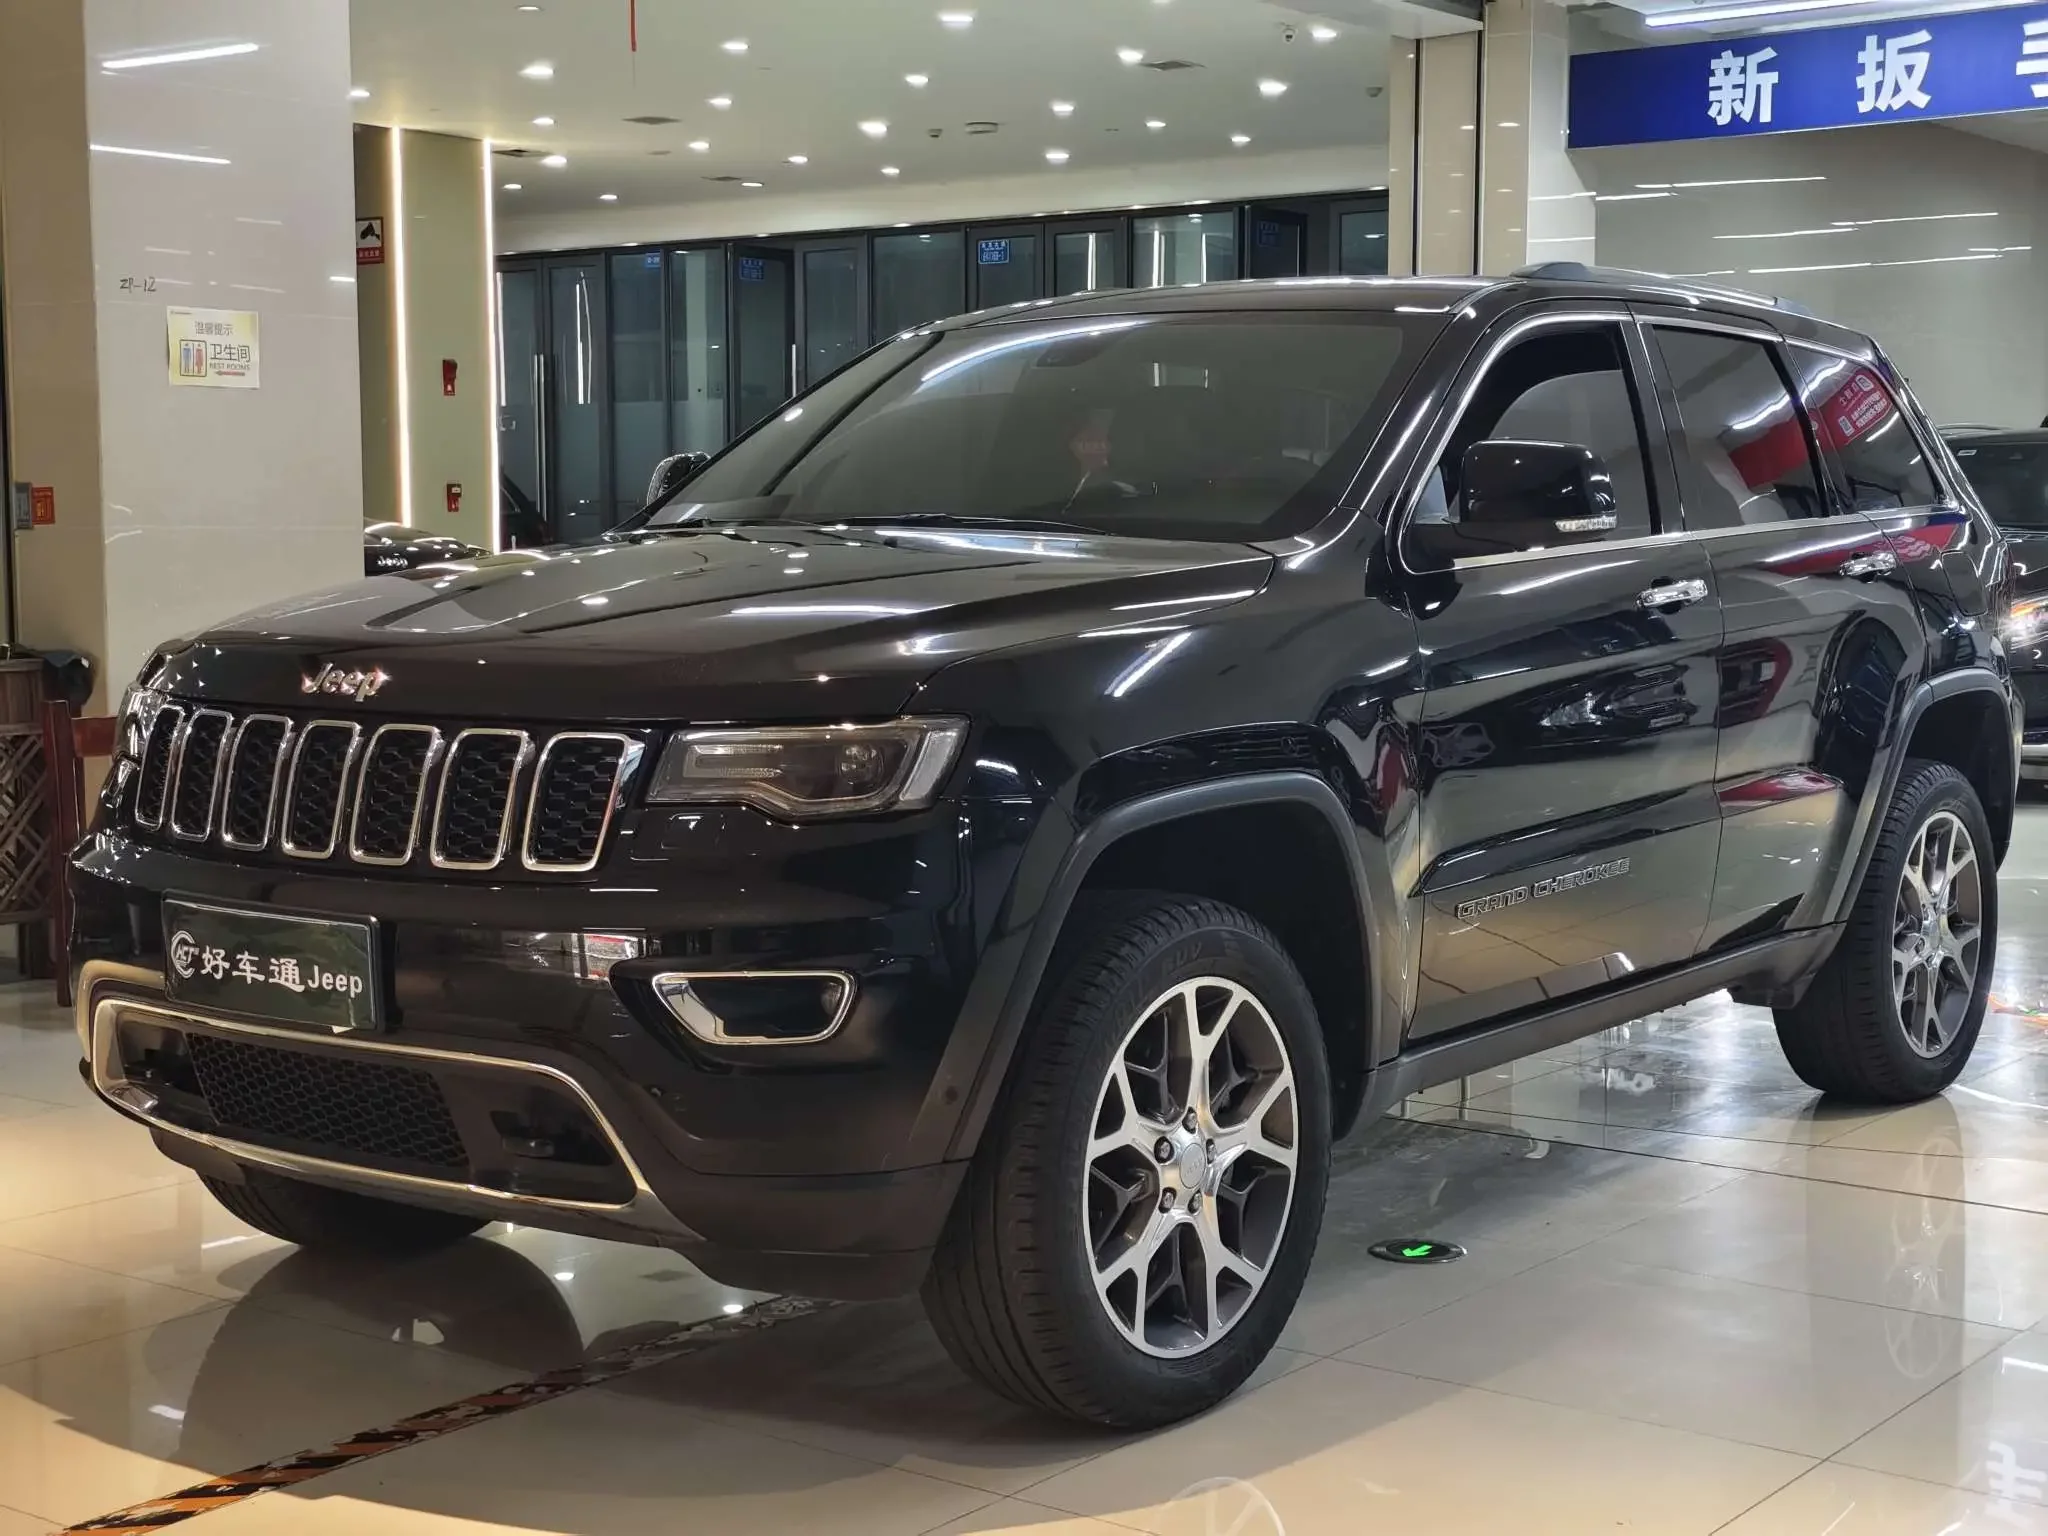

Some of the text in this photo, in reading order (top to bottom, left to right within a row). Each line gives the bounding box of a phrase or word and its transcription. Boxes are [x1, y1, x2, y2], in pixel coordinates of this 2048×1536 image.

[209, 343, 251, 363] 卫生间
[302, 663, 388, 702] Jeep
[1456, 856, 1630, 919] GRAND CHEROKEE
[201, 944, 305, 993] 好车通
[307, 965, 363, 998] Jeep
